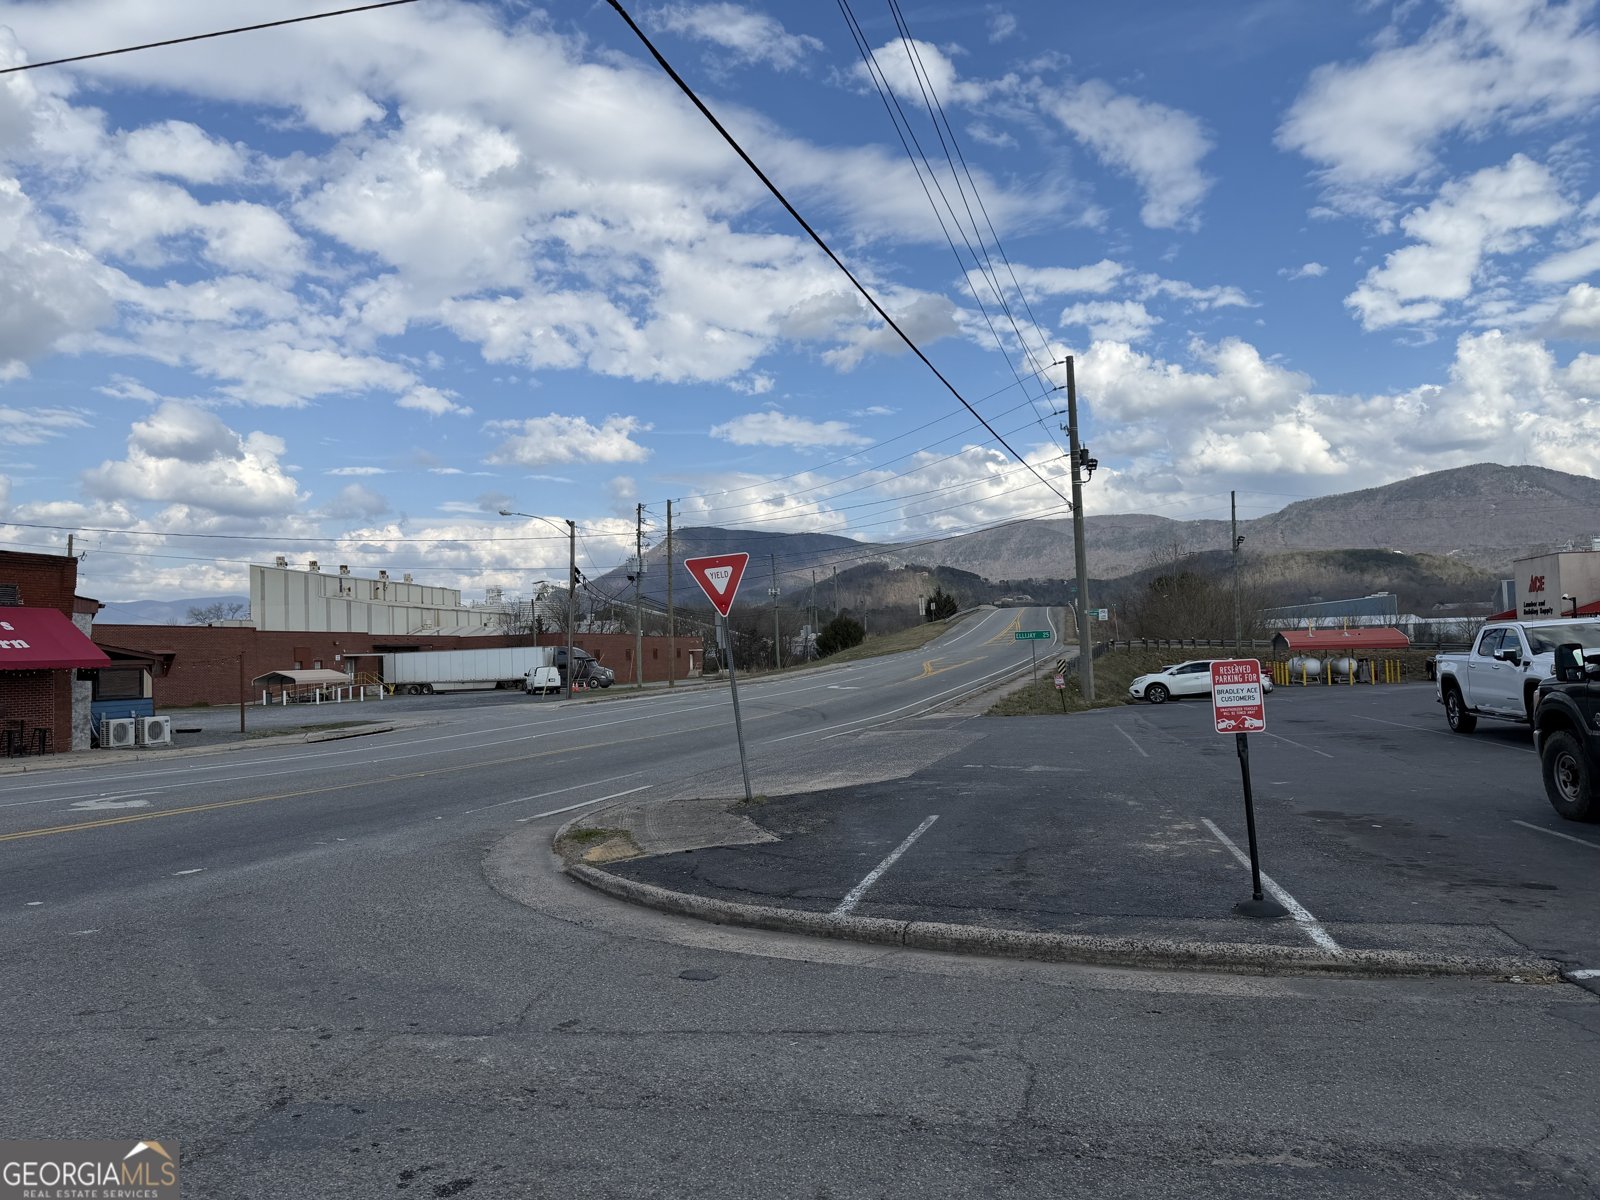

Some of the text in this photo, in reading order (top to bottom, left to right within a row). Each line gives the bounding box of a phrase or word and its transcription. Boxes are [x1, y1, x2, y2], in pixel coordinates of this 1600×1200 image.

[710, 571, 729, 579] YIELD
[1528, 574, 1545, 592] ACE
[1540, 607, 1553, 615] Supply
[1219, 665, 1251, 674] RESERVED
[1215, 673, 1257, 683] PARKING FOR
